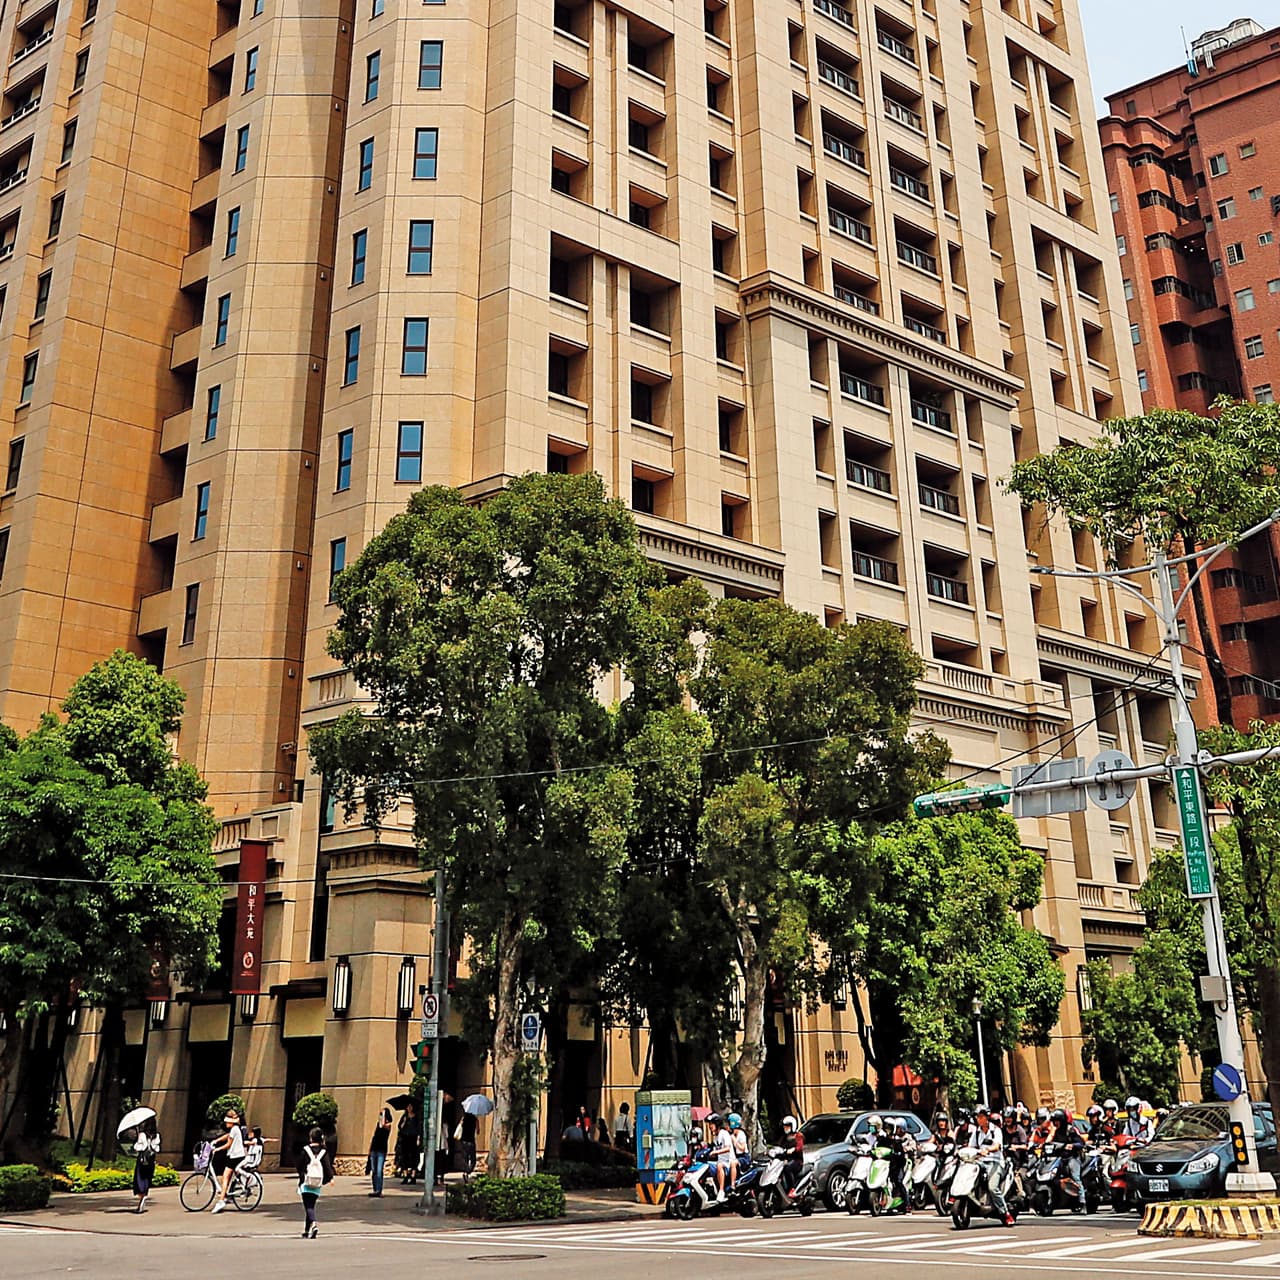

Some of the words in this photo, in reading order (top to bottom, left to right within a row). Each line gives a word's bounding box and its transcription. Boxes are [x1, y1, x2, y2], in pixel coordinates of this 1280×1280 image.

[1181, 779, 1200, 848] 和平東路一段
[246, 884, 257, 939] 和平大苑
